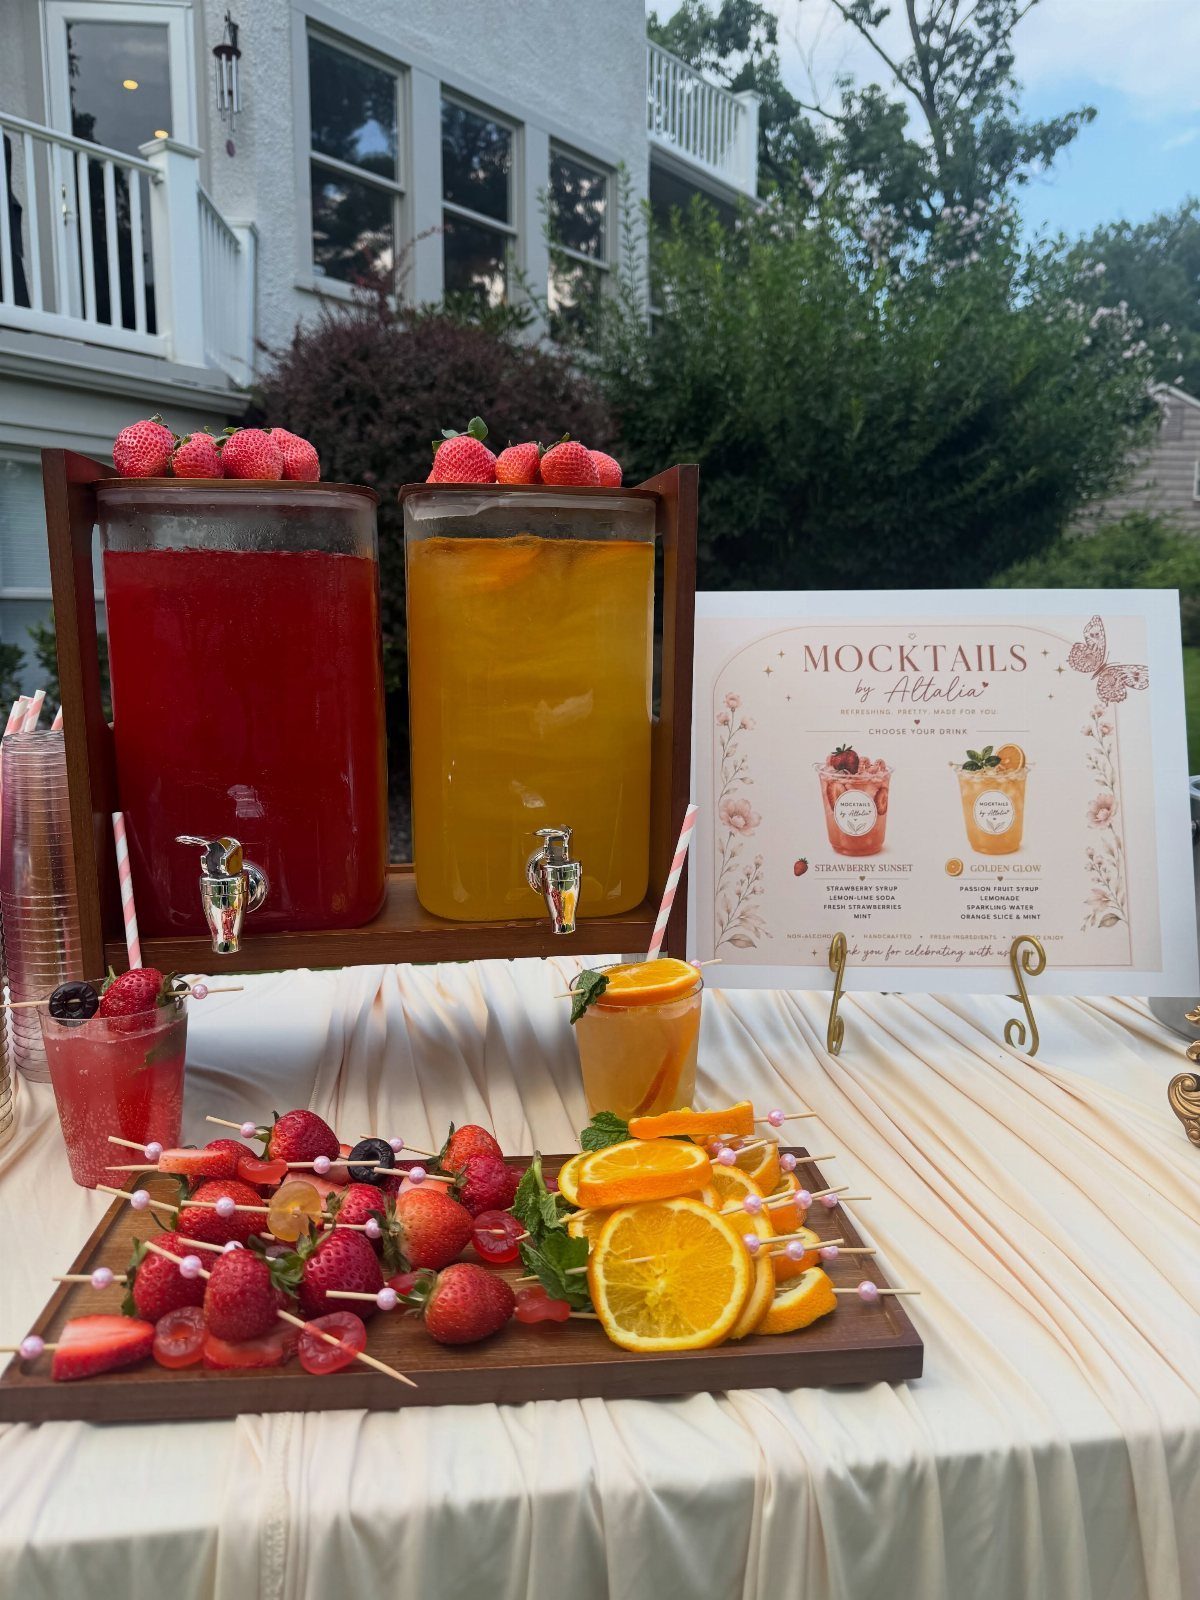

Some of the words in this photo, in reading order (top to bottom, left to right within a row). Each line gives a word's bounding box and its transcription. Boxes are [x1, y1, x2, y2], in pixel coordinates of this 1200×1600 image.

[803, 644, 1028, 673] MOCKTAILS
[854, 678, 876, 703] by
[884, 675, 985, 703] Altalia
[933, 708, 956, 716] MADE
[960, 708, 976, 716] FOR
[814, 863, 876, 872] STRAWBERRY
[878, 863, 913, 872] SUNSET
[970, 864, 1010, 873] GOLDEN
[1012, 864, 1042, 873] GLOW
[863, 950, 884, 962] you
[886, 945, 901, 961] for
[904, 944, 966, 963] celebrating
[968, 945, 994, 957] with
